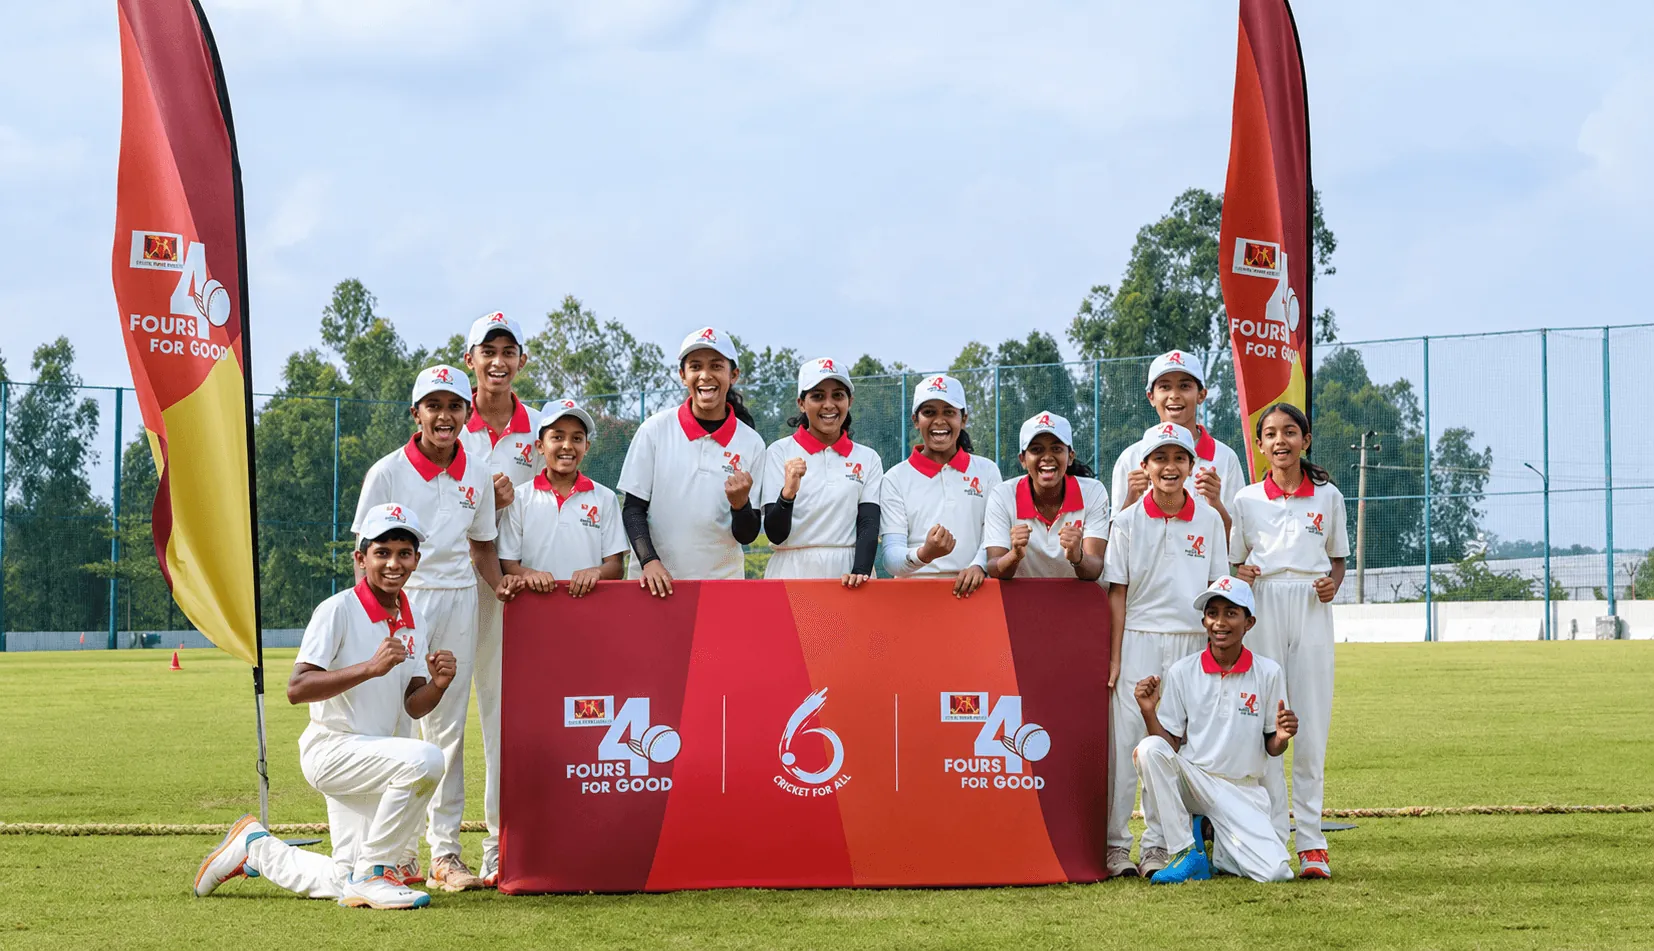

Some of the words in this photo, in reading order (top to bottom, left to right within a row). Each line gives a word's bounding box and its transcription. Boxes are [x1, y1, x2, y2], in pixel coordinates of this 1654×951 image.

[129, 314, 197, 337] FOURS
[1231, 318, 1287, 342] FOURS
[150, 338, 184, 355] FOR
[190, 340, 228, 361] GOOD
[1245, 342, 1277, 359] FOR
[566, 762, 626, 779] FOURS
[944, 758, 1002, 773] FOURS
[581, 782, 611, 794] FOR
[615, 777, 673, 793] GOOD
[773, 775, 810, 797] CRICKET
[812, 785, 833, 797] FOR
[834, 774, 852, 790] ALL
[961, 777, 989, 789] FOR
[993, 776, 1045, 790] GOOD
